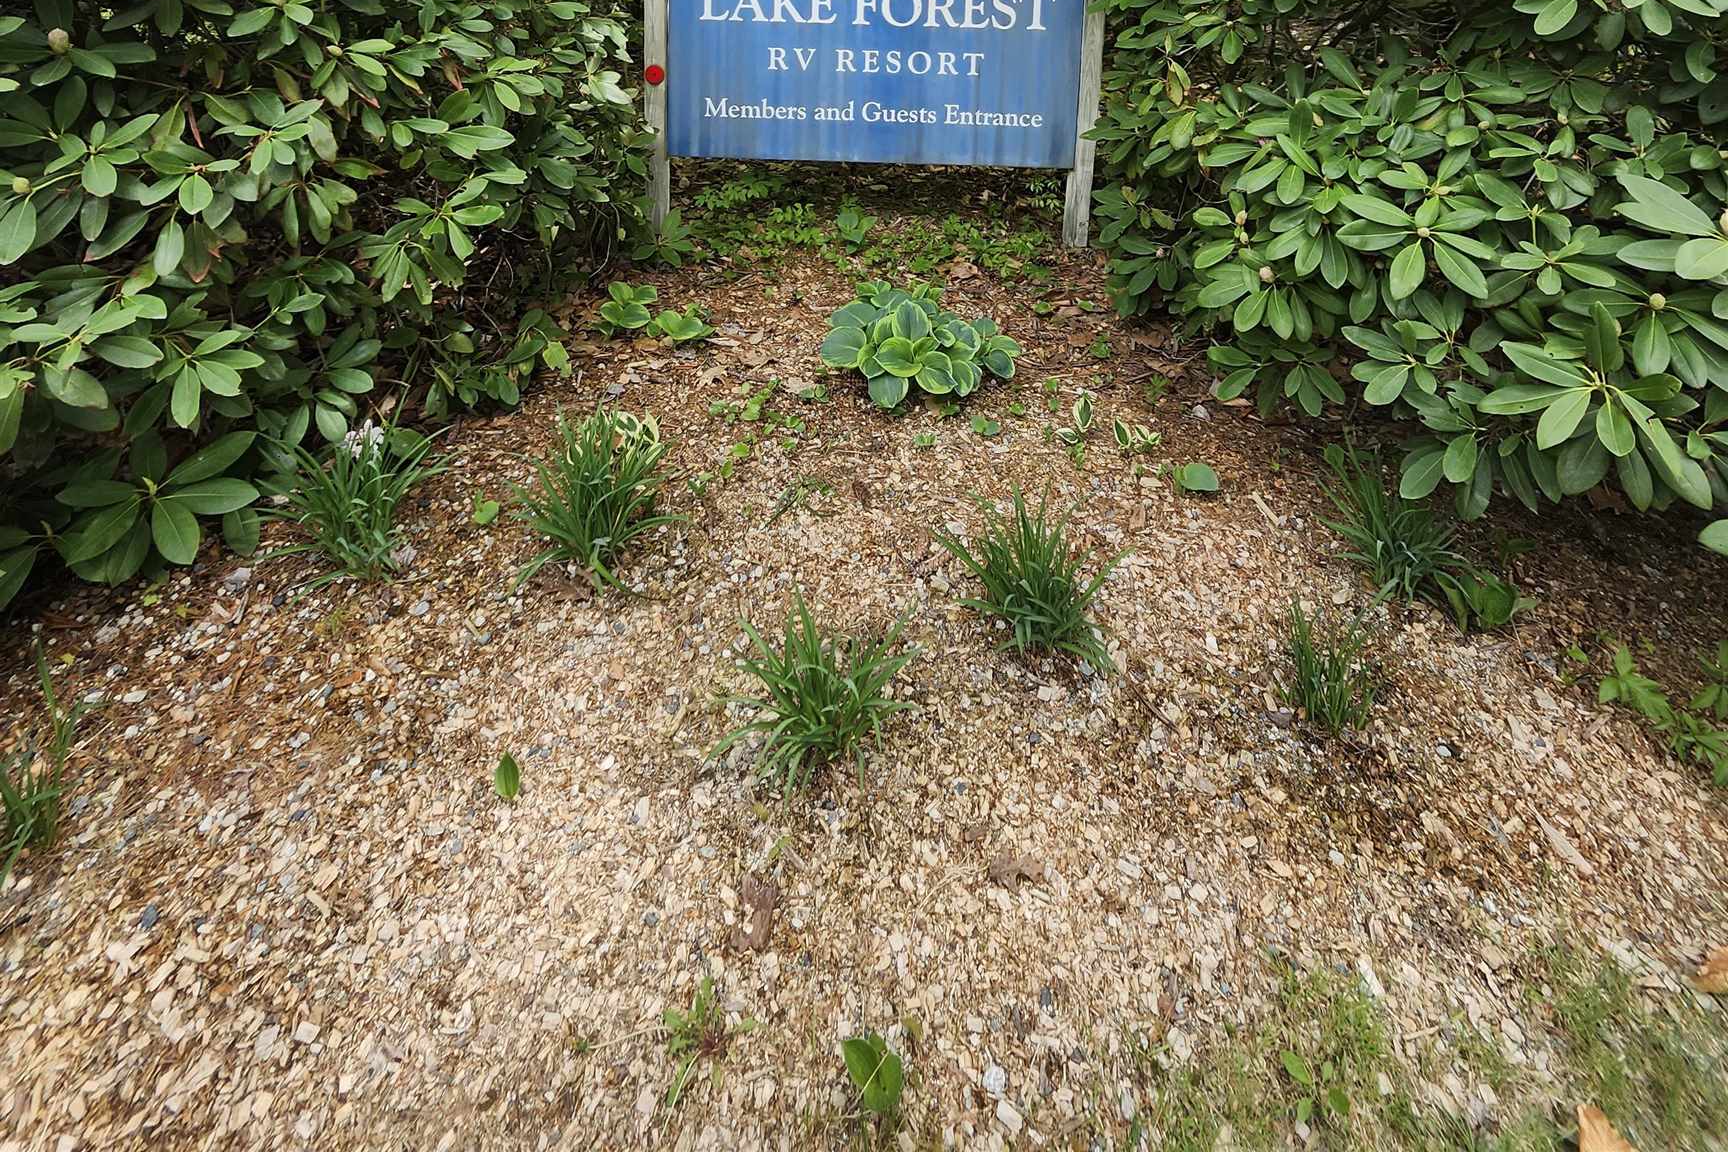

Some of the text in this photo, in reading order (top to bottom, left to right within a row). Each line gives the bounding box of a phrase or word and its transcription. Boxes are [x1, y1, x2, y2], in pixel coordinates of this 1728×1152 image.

[767, 47, 985, 76] RV RESORT
[704, 97, 1043, 128] Members and Guests Entrance
